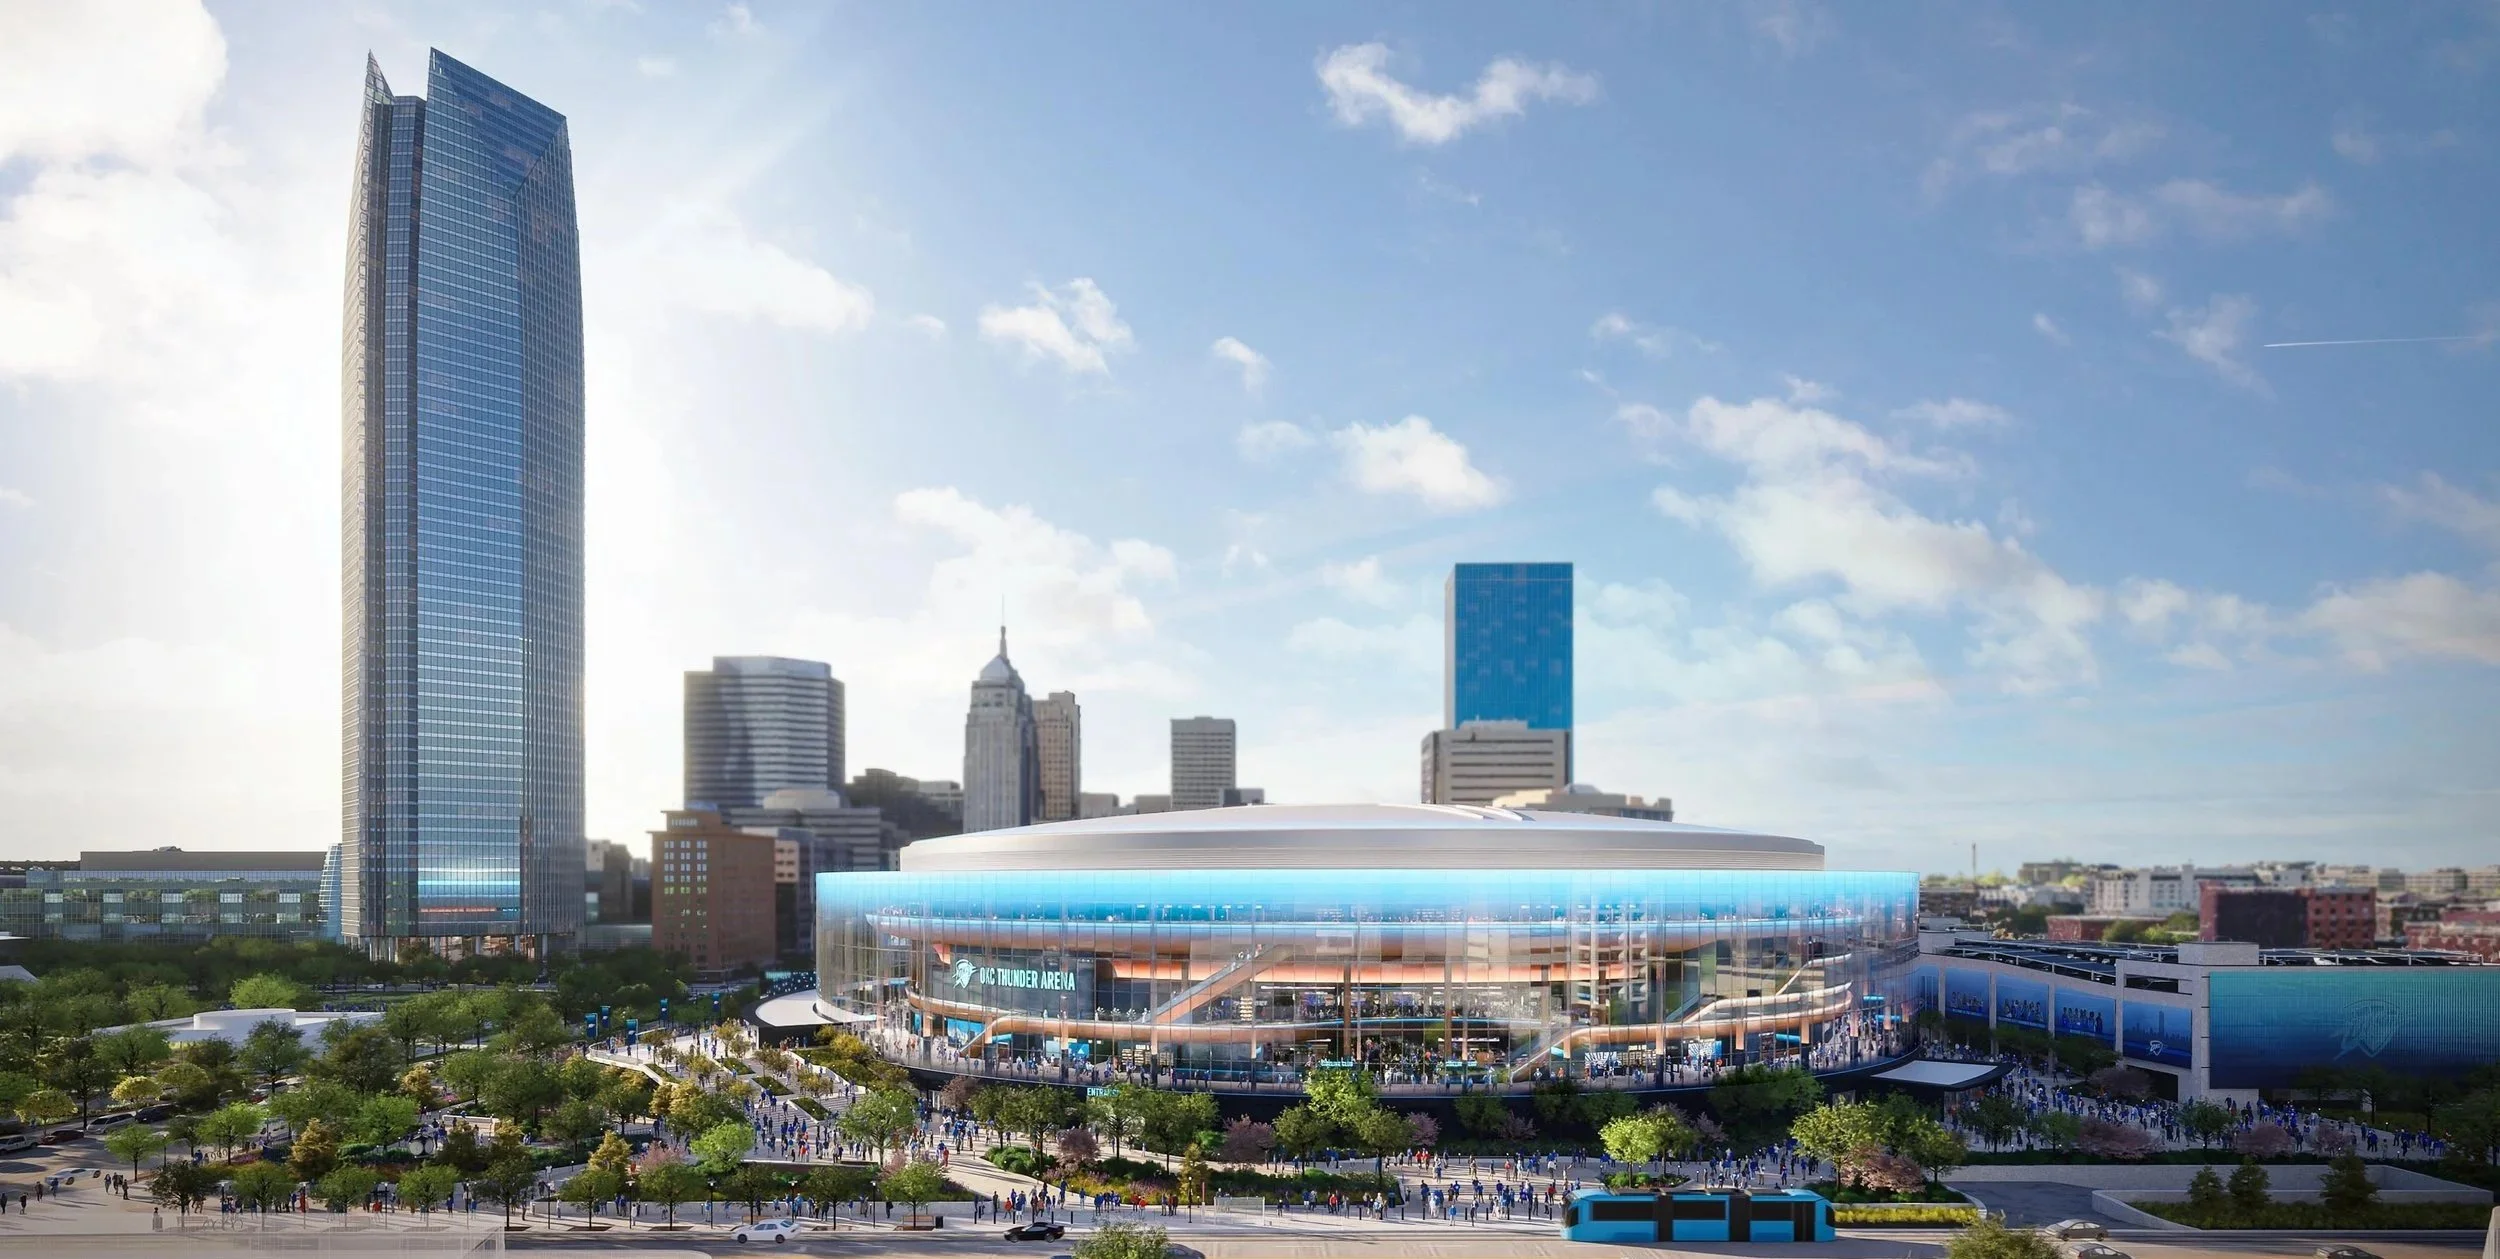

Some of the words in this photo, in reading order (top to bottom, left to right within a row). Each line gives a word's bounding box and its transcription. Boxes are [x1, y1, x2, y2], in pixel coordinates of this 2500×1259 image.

[979, 967, 996, 986] OKC
[997, 968, 1038, 989] THUNDER
[1040, 970, 1076, 991] ARENA
